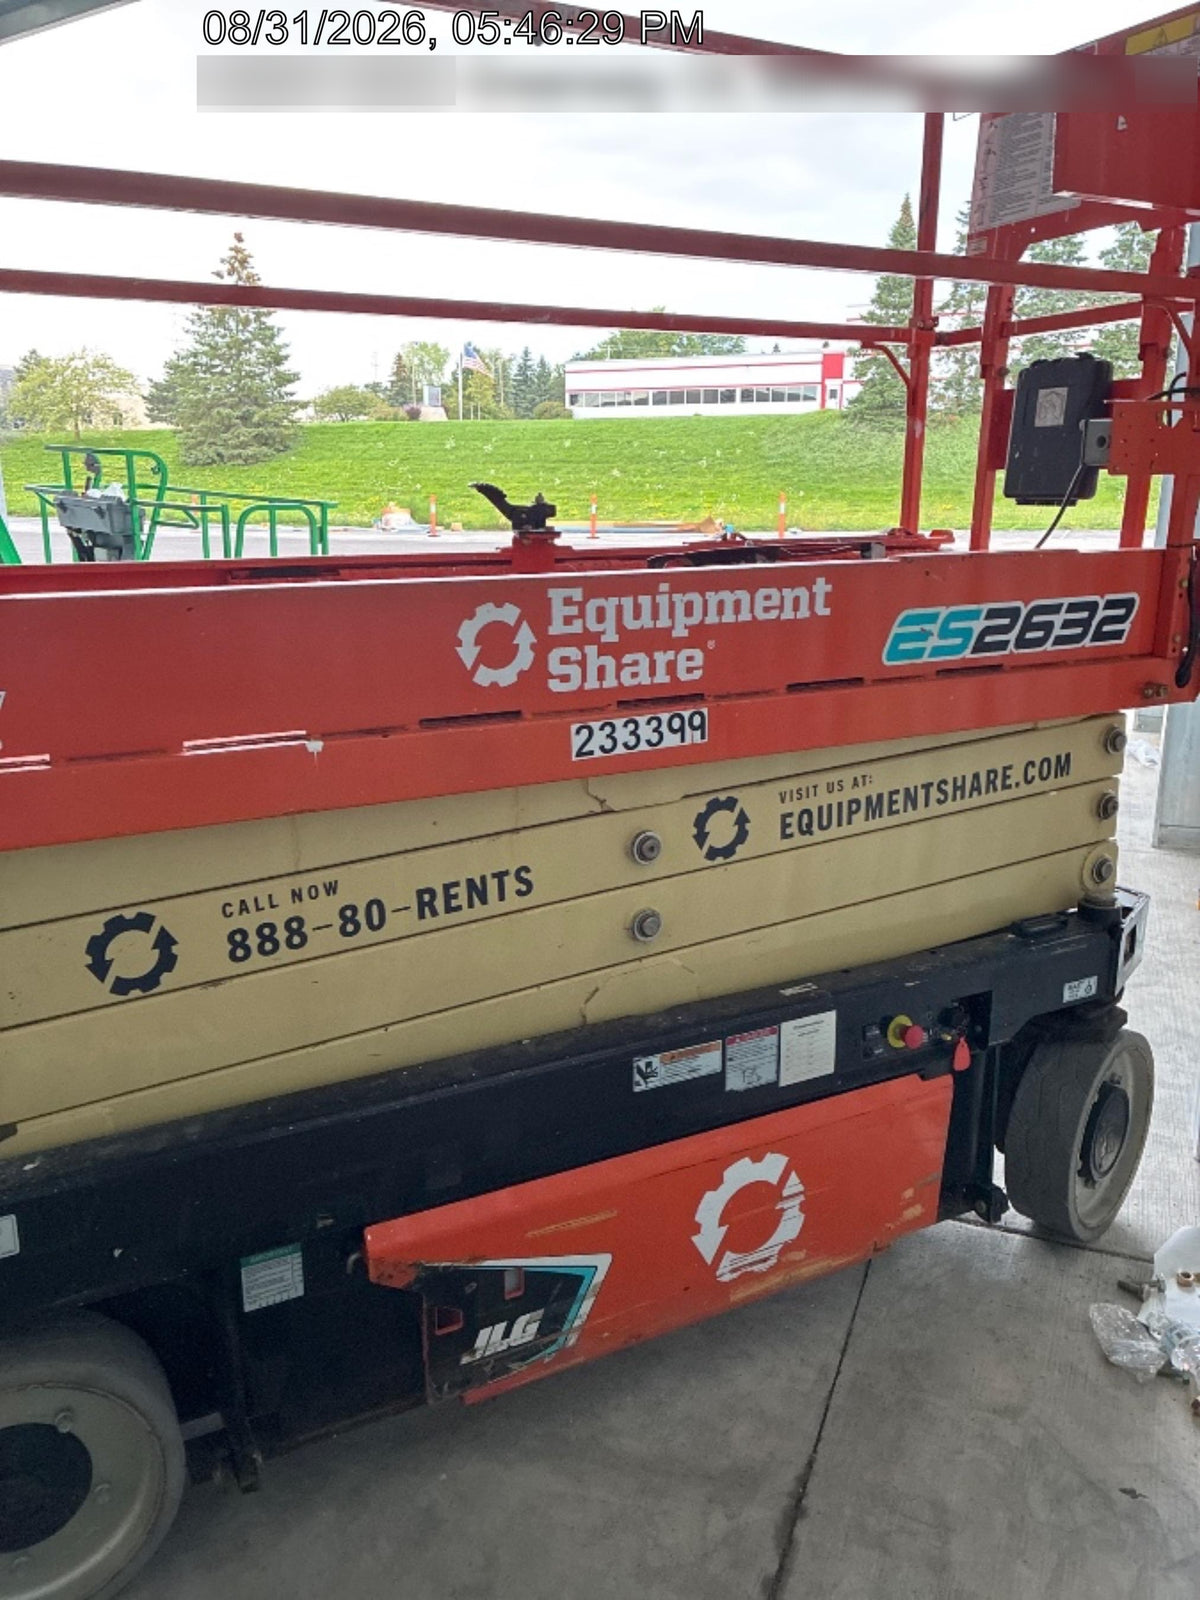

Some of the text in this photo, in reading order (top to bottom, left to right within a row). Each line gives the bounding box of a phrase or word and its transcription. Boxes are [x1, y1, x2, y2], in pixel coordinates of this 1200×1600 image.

[547, 577, 833, 642] Equipment
[882, 592, 1140, 666] ES2632
[574, 709, 707, 758] 233399
[778, 774, 873, 804] VISIT US AT:
[779, 752, 1072, 841] EQUIPMENTSHARE.COM
[222, 879, 339, 918] CALL NOW
[460, 1308, 545, 1366] JLG
